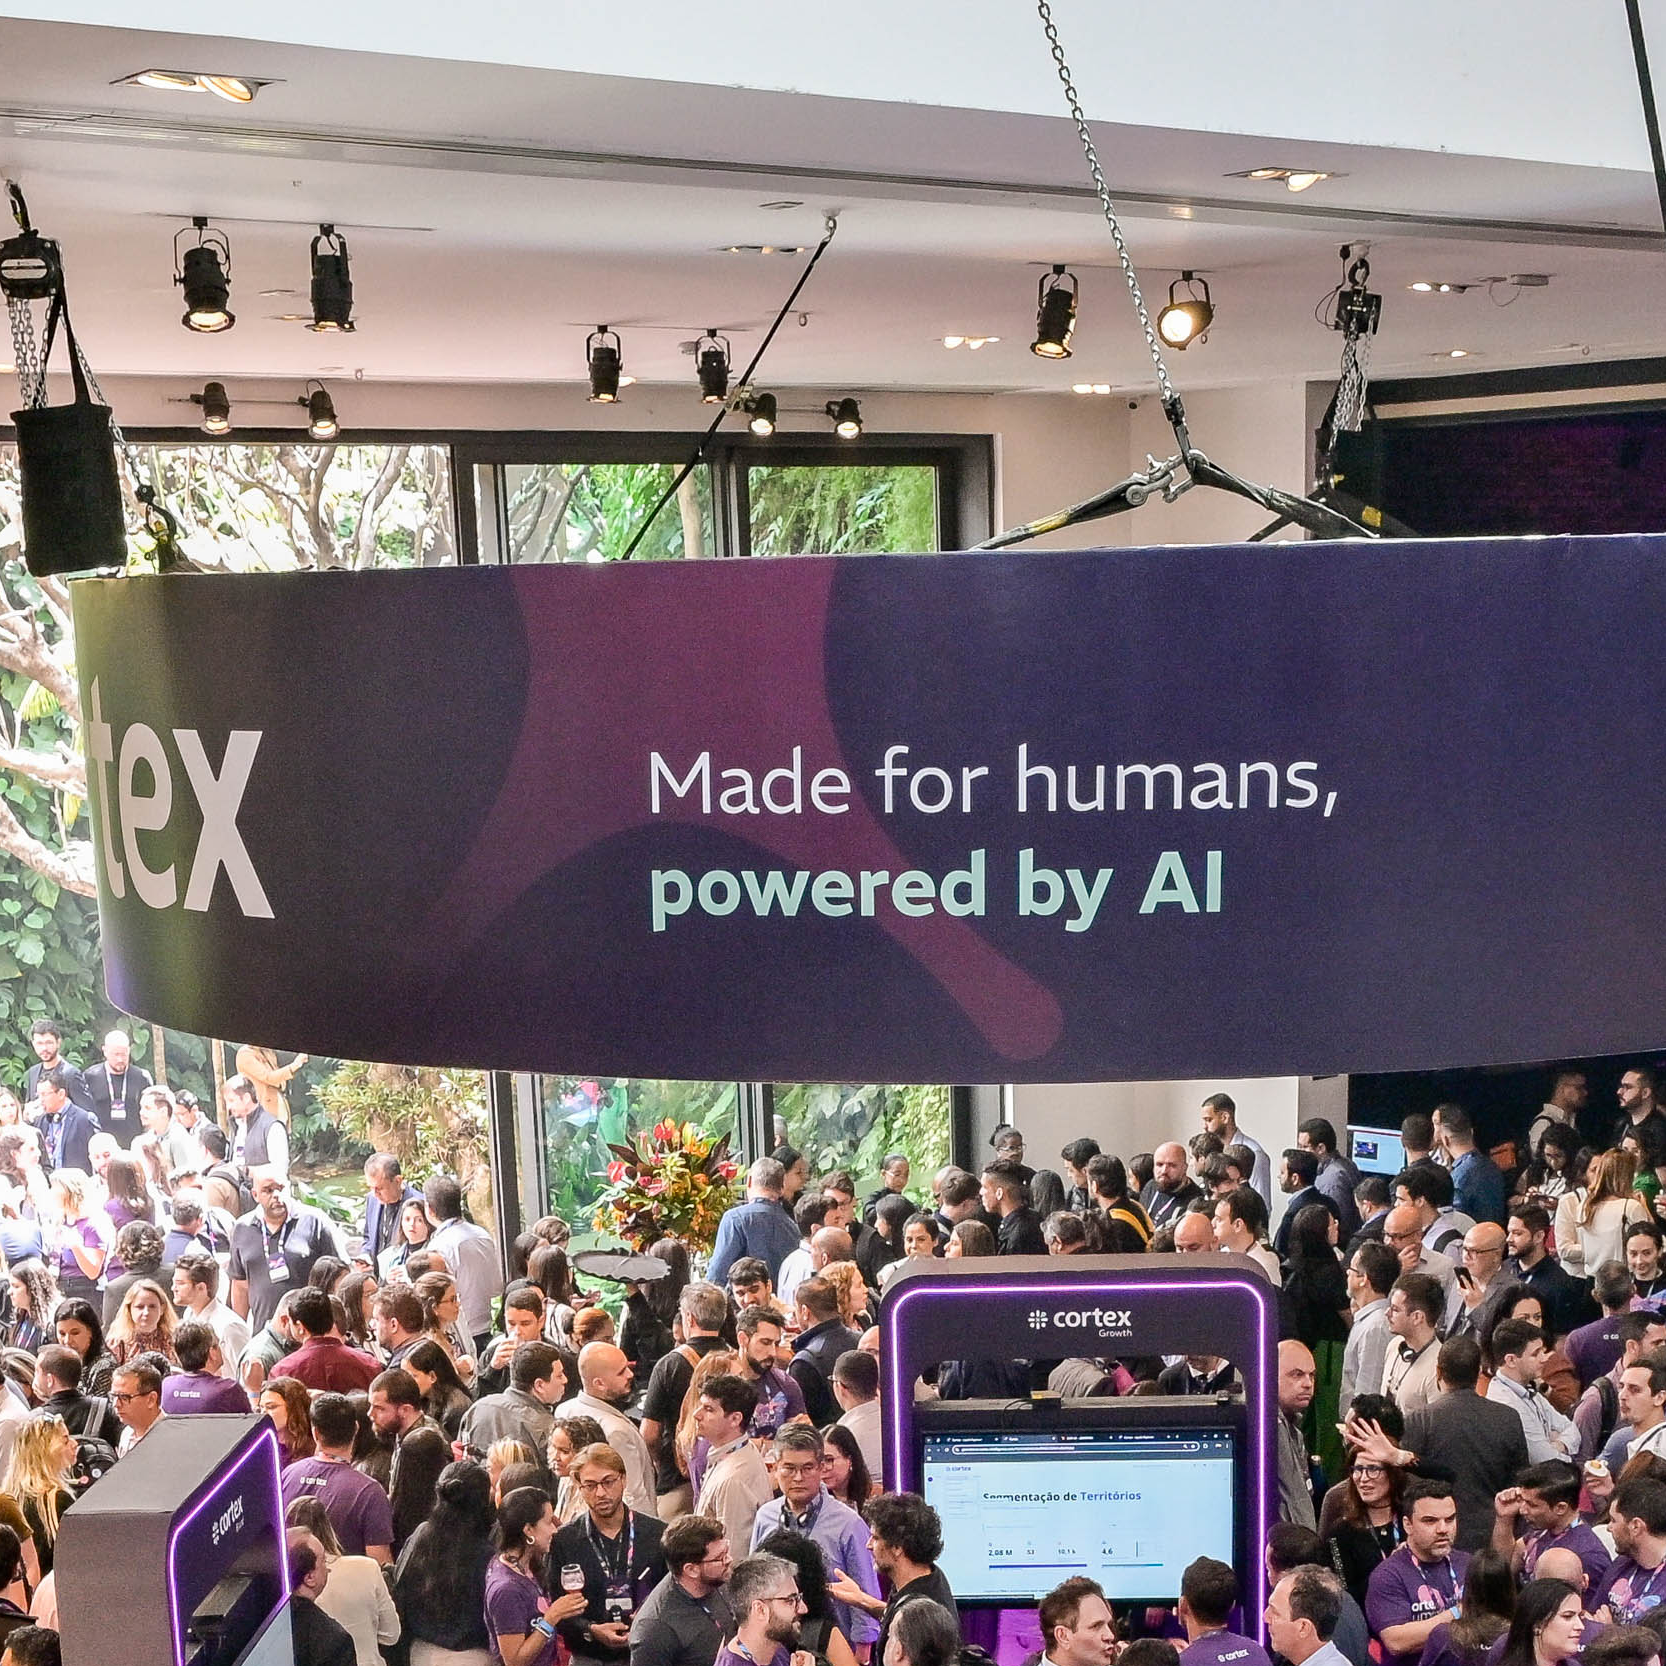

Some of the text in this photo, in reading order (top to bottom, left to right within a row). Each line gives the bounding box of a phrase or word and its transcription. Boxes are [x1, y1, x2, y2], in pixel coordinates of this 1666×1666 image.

[650, 743, 1339, 817] Made for humans,
[90, 674, 275, 919] tex
[652, 848, 1223, 932] powered by AI
[1053, 1308, 1131, 1327] cortex
[1098, 1328, 1132, 1338] Growth
[1063, 1491, 1077, 1501] de
[1081, 1490, 1142, 1501] Territórios
[219, 1495, 243, 1535] cortex
[1225, 1648, 1250, 1660] cortex
